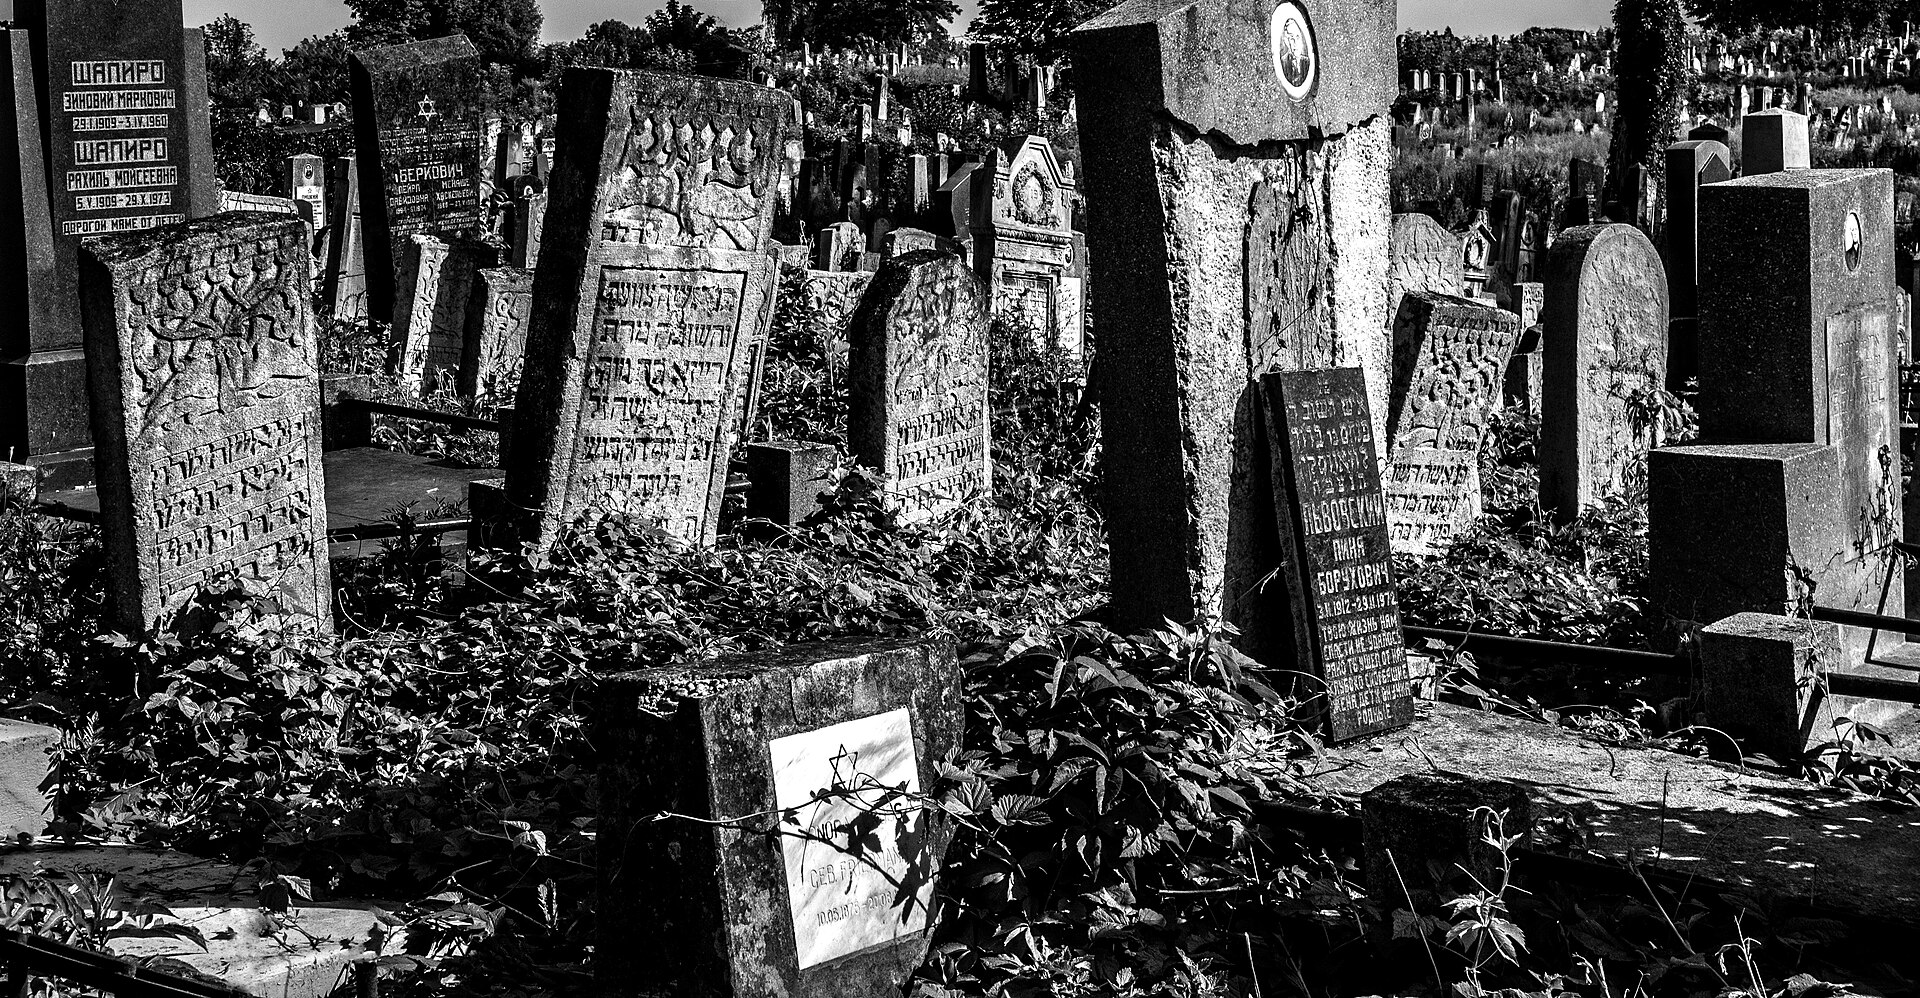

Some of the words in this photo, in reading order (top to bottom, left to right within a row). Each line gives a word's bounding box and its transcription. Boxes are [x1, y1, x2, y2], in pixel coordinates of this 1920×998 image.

[73, 61, 164, 83] ШАПИРО
[117, 90, 174, 109] МАРКОВИЧ
[75, 139, 166, 162] ШАПИРО
[68, 171, 109, 189] РАХИЛЬ
[114, 167, 176, 187] МОИСЕЕВНА
[399, 164, 464, 182] БЕРКОВИЧ
[111, 218, 138, 231] МАМЕ
[140, 217, 152, 228] ОТ
[1332, 536, 1366, 562] ПИНЯ
[1316, 561, 1390, 595] БОРУХОВИЧ
[1347, 616, 1378, 637] ЖИЗНЬ
[1379, 614, 1398, 631] НАМ
[1355, 635, 1366, 653] НЕ
[1357, 703, 1392, 727] РОДНЫЕ
